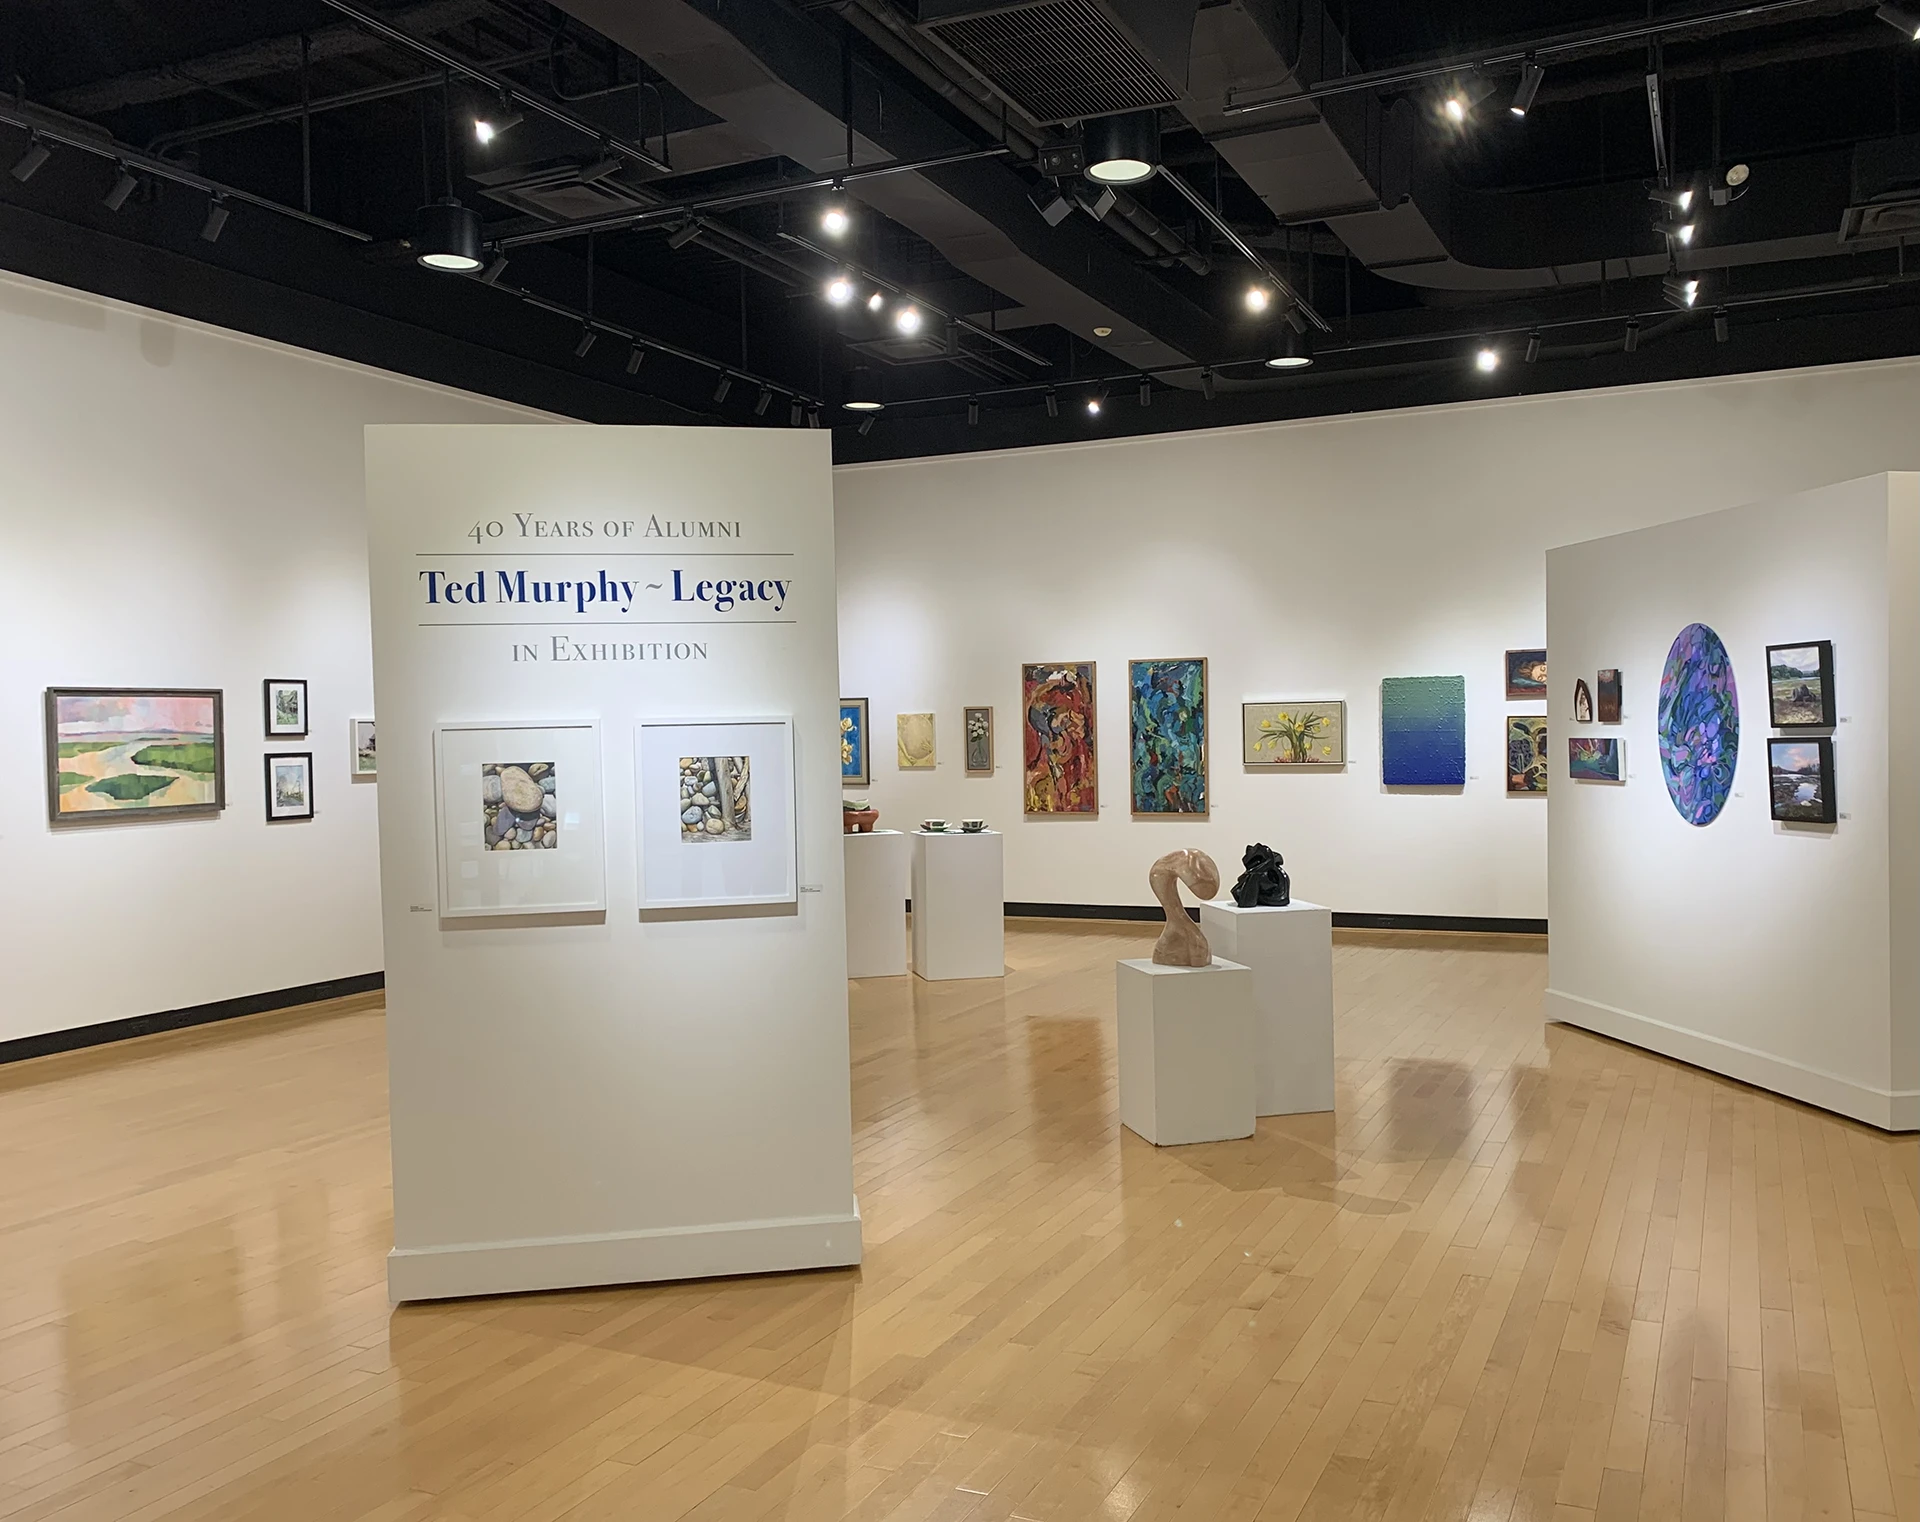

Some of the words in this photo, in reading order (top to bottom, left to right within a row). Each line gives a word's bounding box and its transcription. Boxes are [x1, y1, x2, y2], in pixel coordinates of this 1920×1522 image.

[467, 520, 504, 545] 40
[418, 570, 488, 605] Ted
[495, 569, 640, 614] Murphy
[671, 569, 793, 613] Legacy
